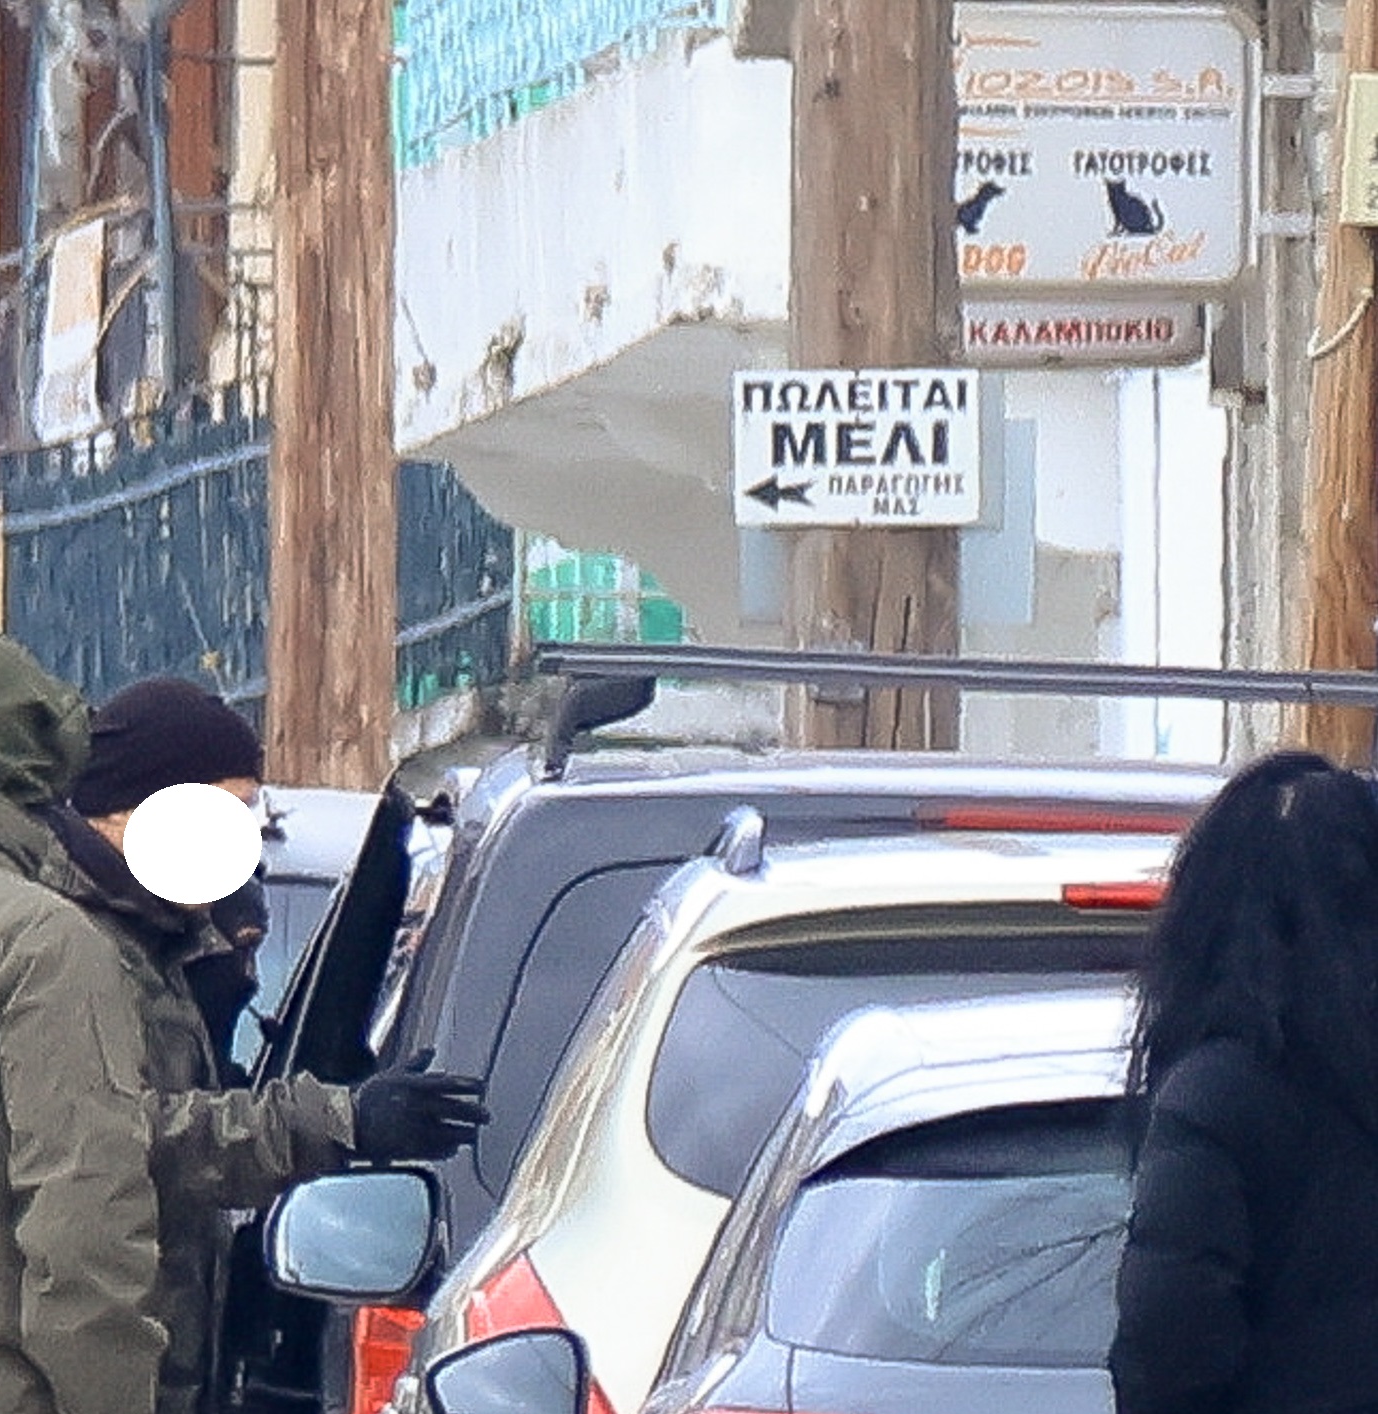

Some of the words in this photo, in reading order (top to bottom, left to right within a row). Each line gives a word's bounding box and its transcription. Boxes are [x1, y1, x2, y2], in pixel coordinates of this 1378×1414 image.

[957, 151, 1033, 176] ΡΟΦΕΣ
[743, 379, 968, 412] ΠΩΛΕΙΤΑΙ
[772, 420, 949, 466] ΜΕΛΙ
[873, 497, 921, 517] ΜΑΣ
